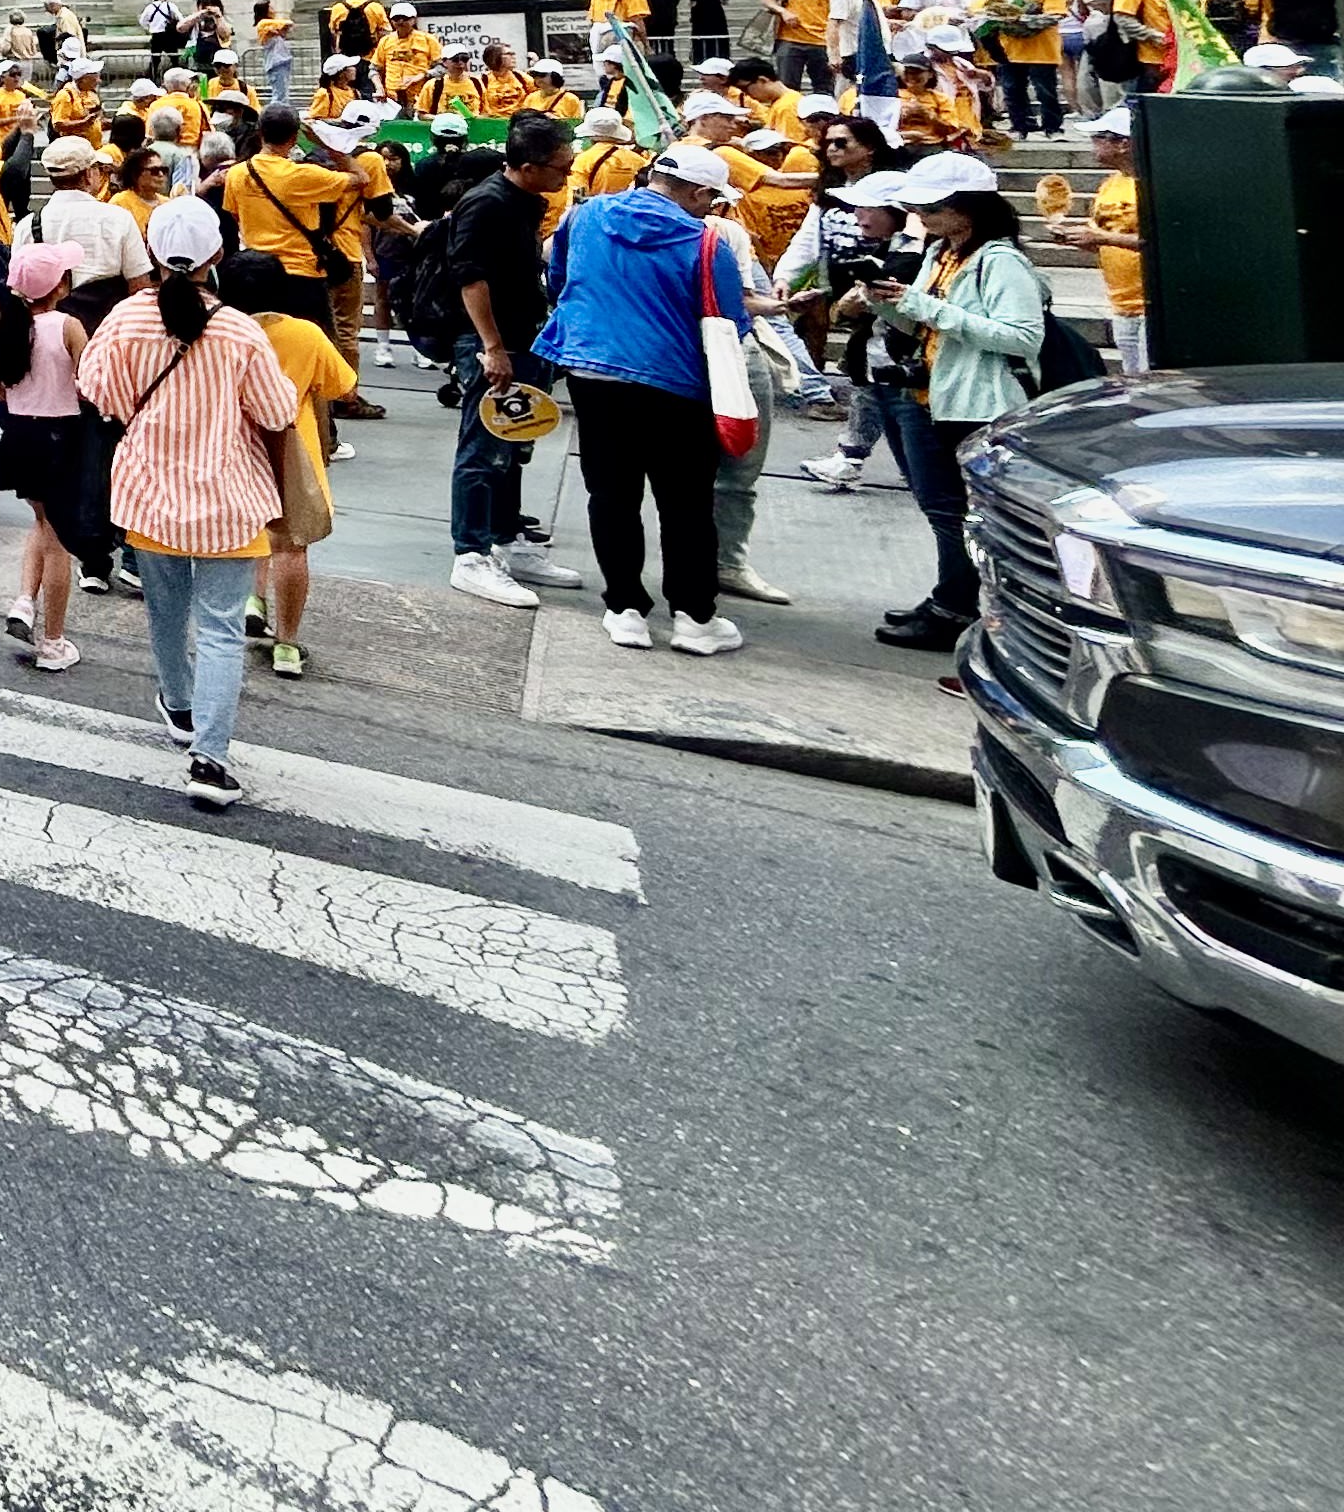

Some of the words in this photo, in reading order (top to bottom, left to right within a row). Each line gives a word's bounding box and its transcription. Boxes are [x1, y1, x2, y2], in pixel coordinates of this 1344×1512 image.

[427, 21, 482, 36] Explore
[439, 35, 476, 46] hat's
[479, 34, 501, 46] On
